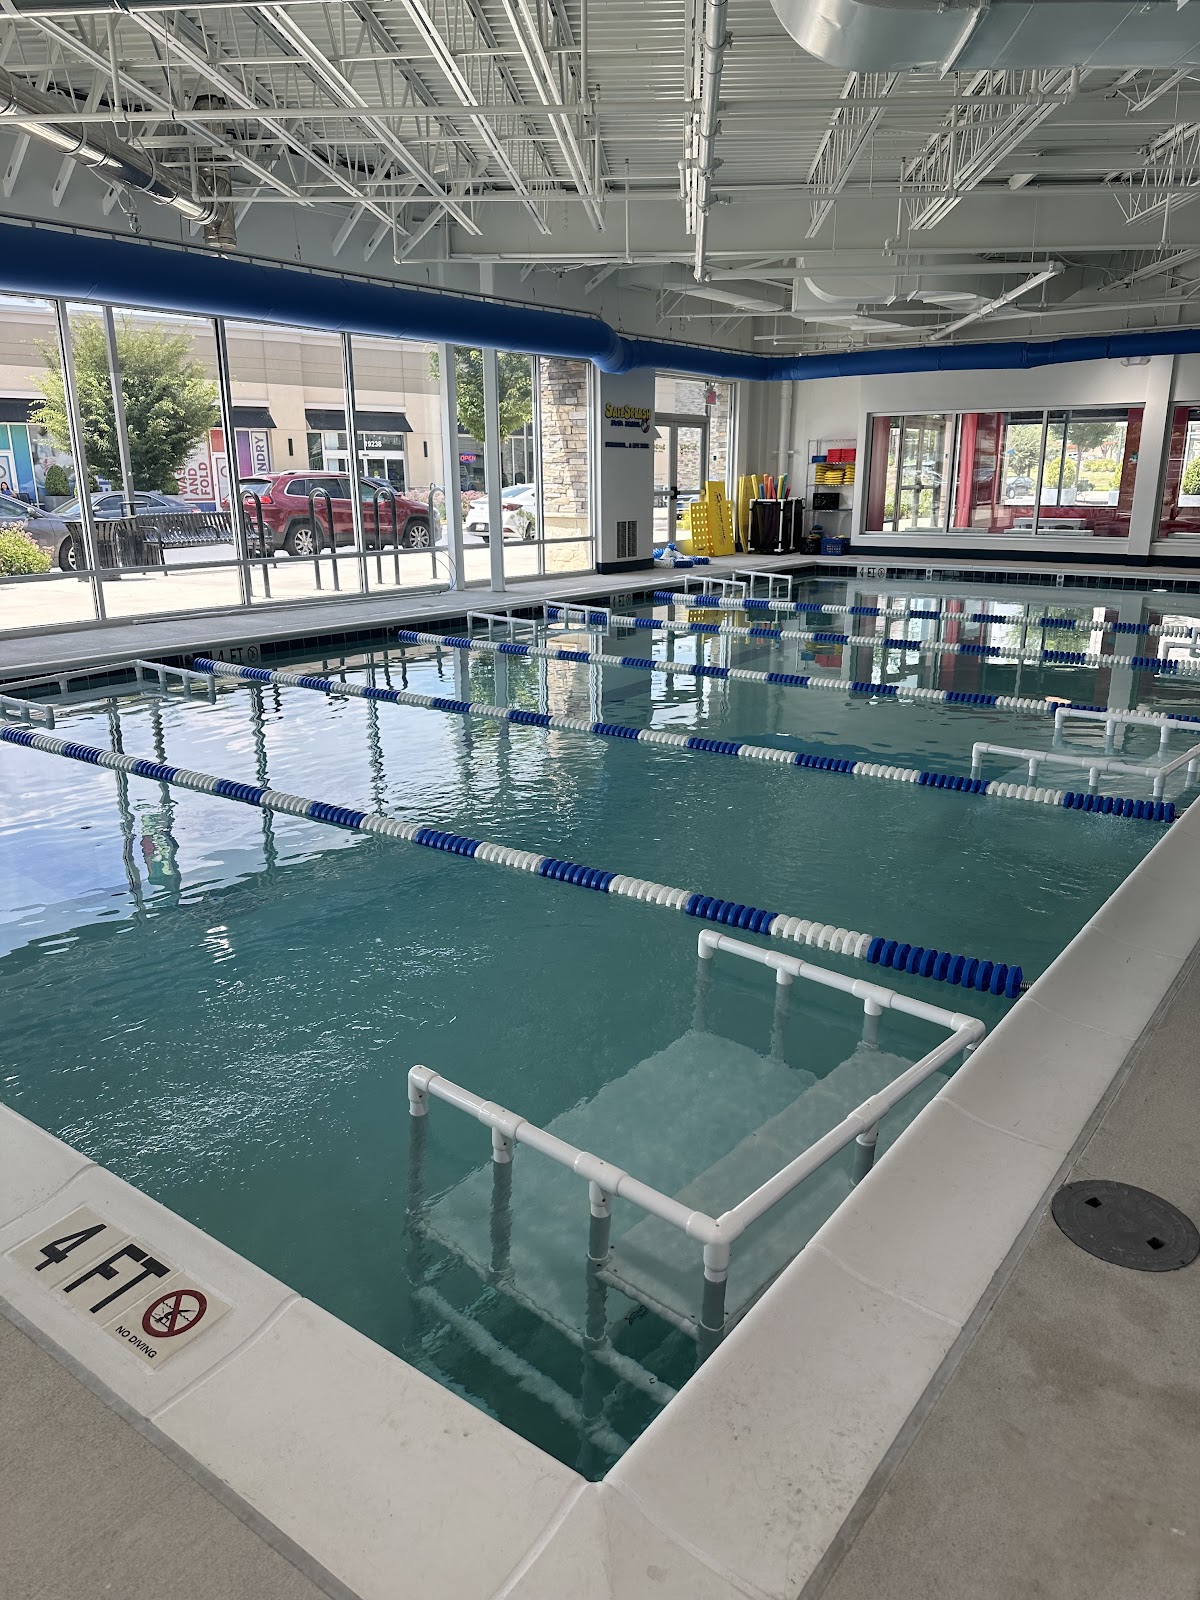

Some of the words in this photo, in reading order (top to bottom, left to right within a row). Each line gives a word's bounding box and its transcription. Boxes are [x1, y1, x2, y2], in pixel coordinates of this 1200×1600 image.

[254, 436, 266, 471] NDRY
[177, 467, 188, 495] WAS
[188, 468, 199, 496] AND
[198, 462, 211, 495] FOLD
[34, 1223, 107, 1272] 4
[63, 1243, 171, 1314] FT
[115, 1325, 131, 1338] NO
[128, 1335, 157, 1359] DIVING
